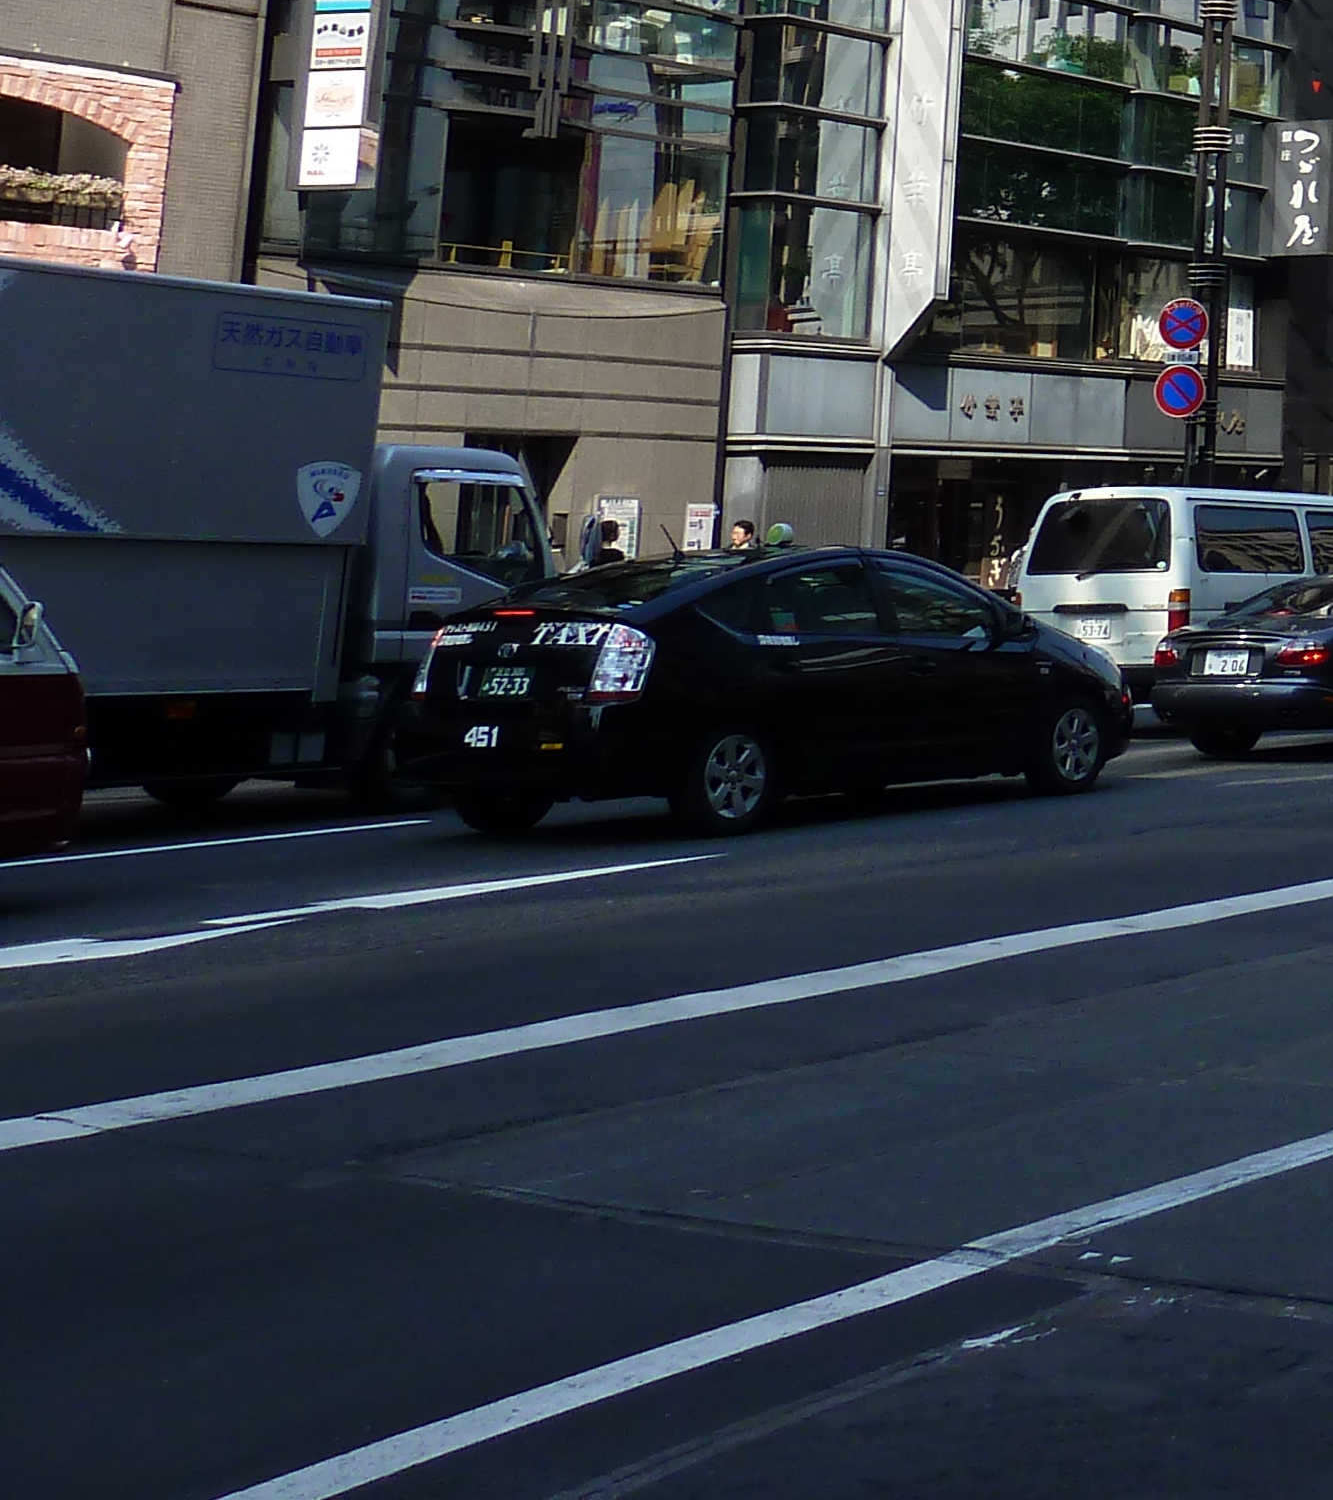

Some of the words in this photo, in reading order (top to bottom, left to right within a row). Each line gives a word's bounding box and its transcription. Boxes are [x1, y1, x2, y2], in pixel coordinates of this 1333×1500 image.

[220, 320, 363, 356] 天然ガス自動車
[531, 623, 611, 646] TAXI
[490, 677, 531, 695] 52-33
[464, 725, 499, 747] 451
